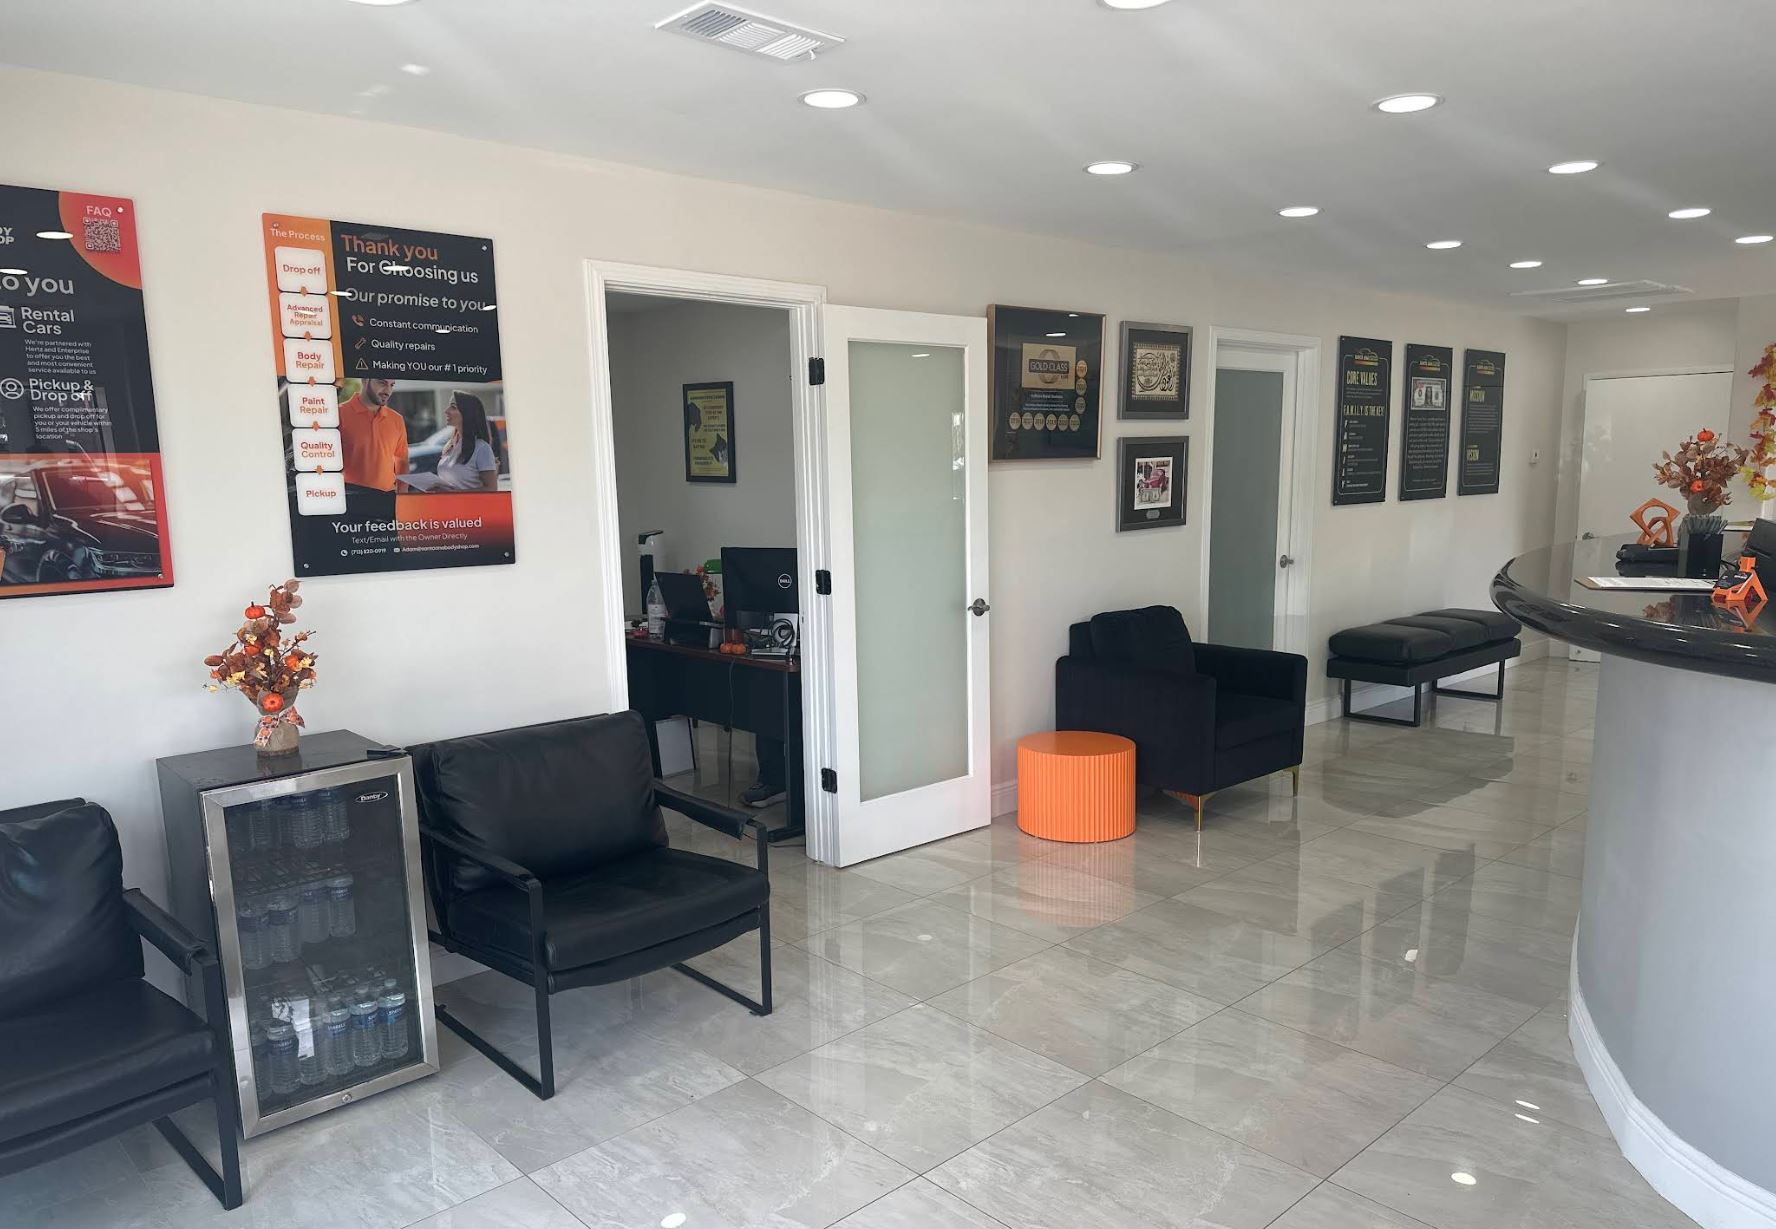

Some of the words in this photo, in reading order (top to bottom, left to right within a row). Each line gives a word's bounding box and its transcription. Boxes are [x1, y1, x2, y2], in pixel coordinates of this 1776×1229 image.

[86, 205, 112, 217] FAQ
[271, 228, 287, 238] The
[289, 230, 325, 241] Process
[341, 235, 400, 255] Thank
[402, 243, 438, 262] you
[283, 264, 306, 275] Drop
[307, 266, 321, 275] off
[347, 257, 375, 274] For
[379, 260, 457, 284] Choosing
[460, 270, 479, 283] us
[0, 275, 20, 291] o
[24, 277, 74, 297] you
[345, 288, 374, 302] Our
[377, 293, 438, 307] promise
[442, 296, 457, 308] to
[459, 301, 486, 312] you
[21, 307, 75, 322] Rental
[287, 304, 323, 313] Advanced
[294, 311, 317, 320] Repair
[23, 321, 62, 335] Cars
[290, 318, 323, 327] Appraisal
[370, 318, 411, 330] Constant
[412, 321, 479, 333] communication
[371, 339, 404, 351] Quality
[405, 342, 436, 351] repairs
[297, 352, 321, 362] Body
[295, 361, 325, 370] Repair
[373, 360, 405, 371] Making
[407, 362, 427, 371] YOU
[457, 365, 488, 375] priority
[1030, 361, 1048, 371] GOLD
[1049, 362, 1068, 371] CLASS
[1347, 370, 1359, 385] CORE
[1360, 371, 1378, 386] VALUES
[29, 378, 80, 392] Pickup
[83, 380, 94, 391] &
[31, 389, 67, 403] Drop
[71, 391, 92, 401] off
[302, 397, 325, 405] Paint
[300, 405, 328, 415] Repair
[301, 441, 333, 451] Quality
[301, 450, 335, 458] Control
[306, 490, 336, 499] Pickup
[332, 522, 362, 534] Your
[365, 519, 427, 533] feedback
[430, 519, 440, 529] is
[442, 517, 482, 529] valued
[352, 535, 389, 544] Text/Email
[390, 534, 405, 543] with
[405, 534, 417, 542] the
[418, 533, 441, 541] Owner
[442, 532, 468, 540] Directly
